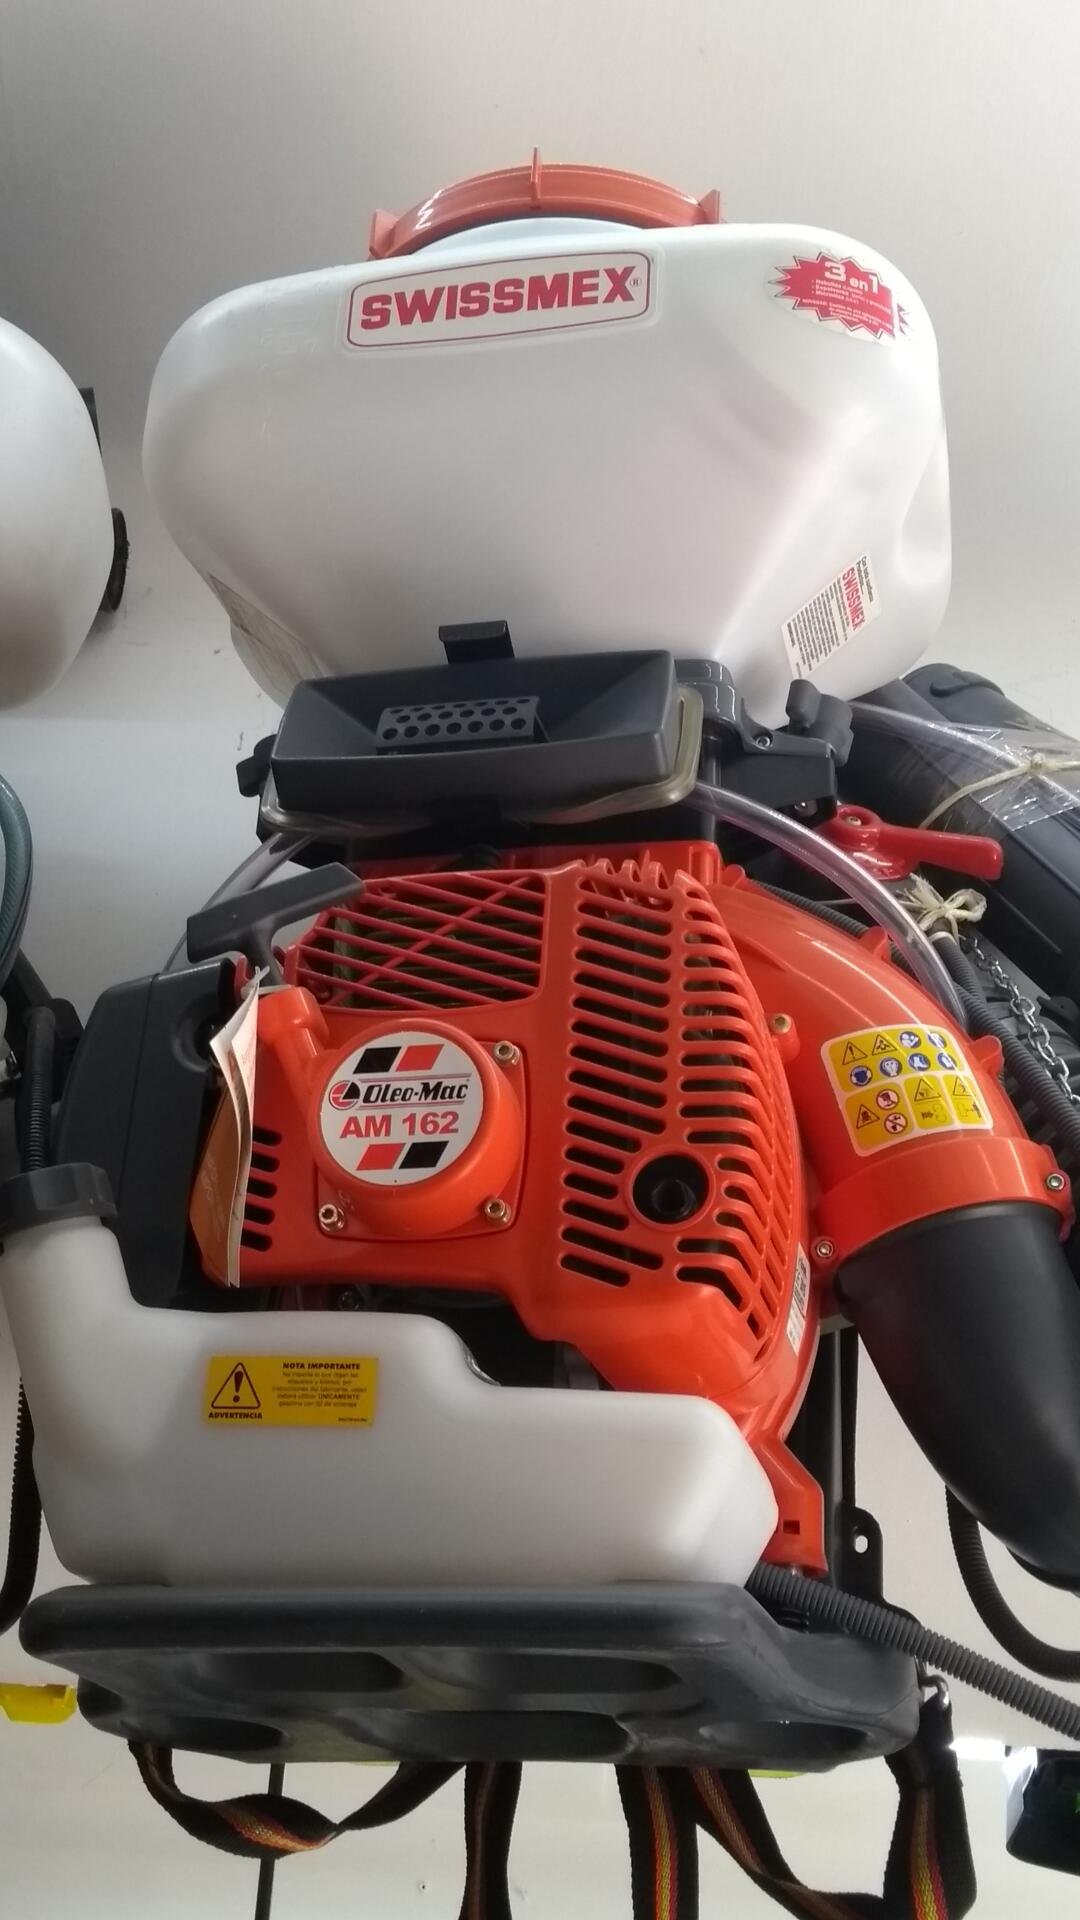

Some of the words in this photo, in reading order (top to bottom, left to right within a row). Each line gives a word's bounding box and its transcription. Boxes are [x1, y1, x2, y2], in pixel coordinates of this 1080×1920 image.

[825, 261, 847, 282] 3
[849, 277, 869, 292] en
[868, 274, 879, 294] 1
[842, 567, 866, 631] SWISSMEX
[362, 1081, 469, 1104] Oleo-Mac
[340, 1114, 392, 1139] AM
[402, 1111, 460, 1136] 162
[282, 1362, 305, 1370] NOTA
[308, 1362, 361, 1370] IMPORTANTE
[208, 1411, 263, 1419] ADVERTENCIA
